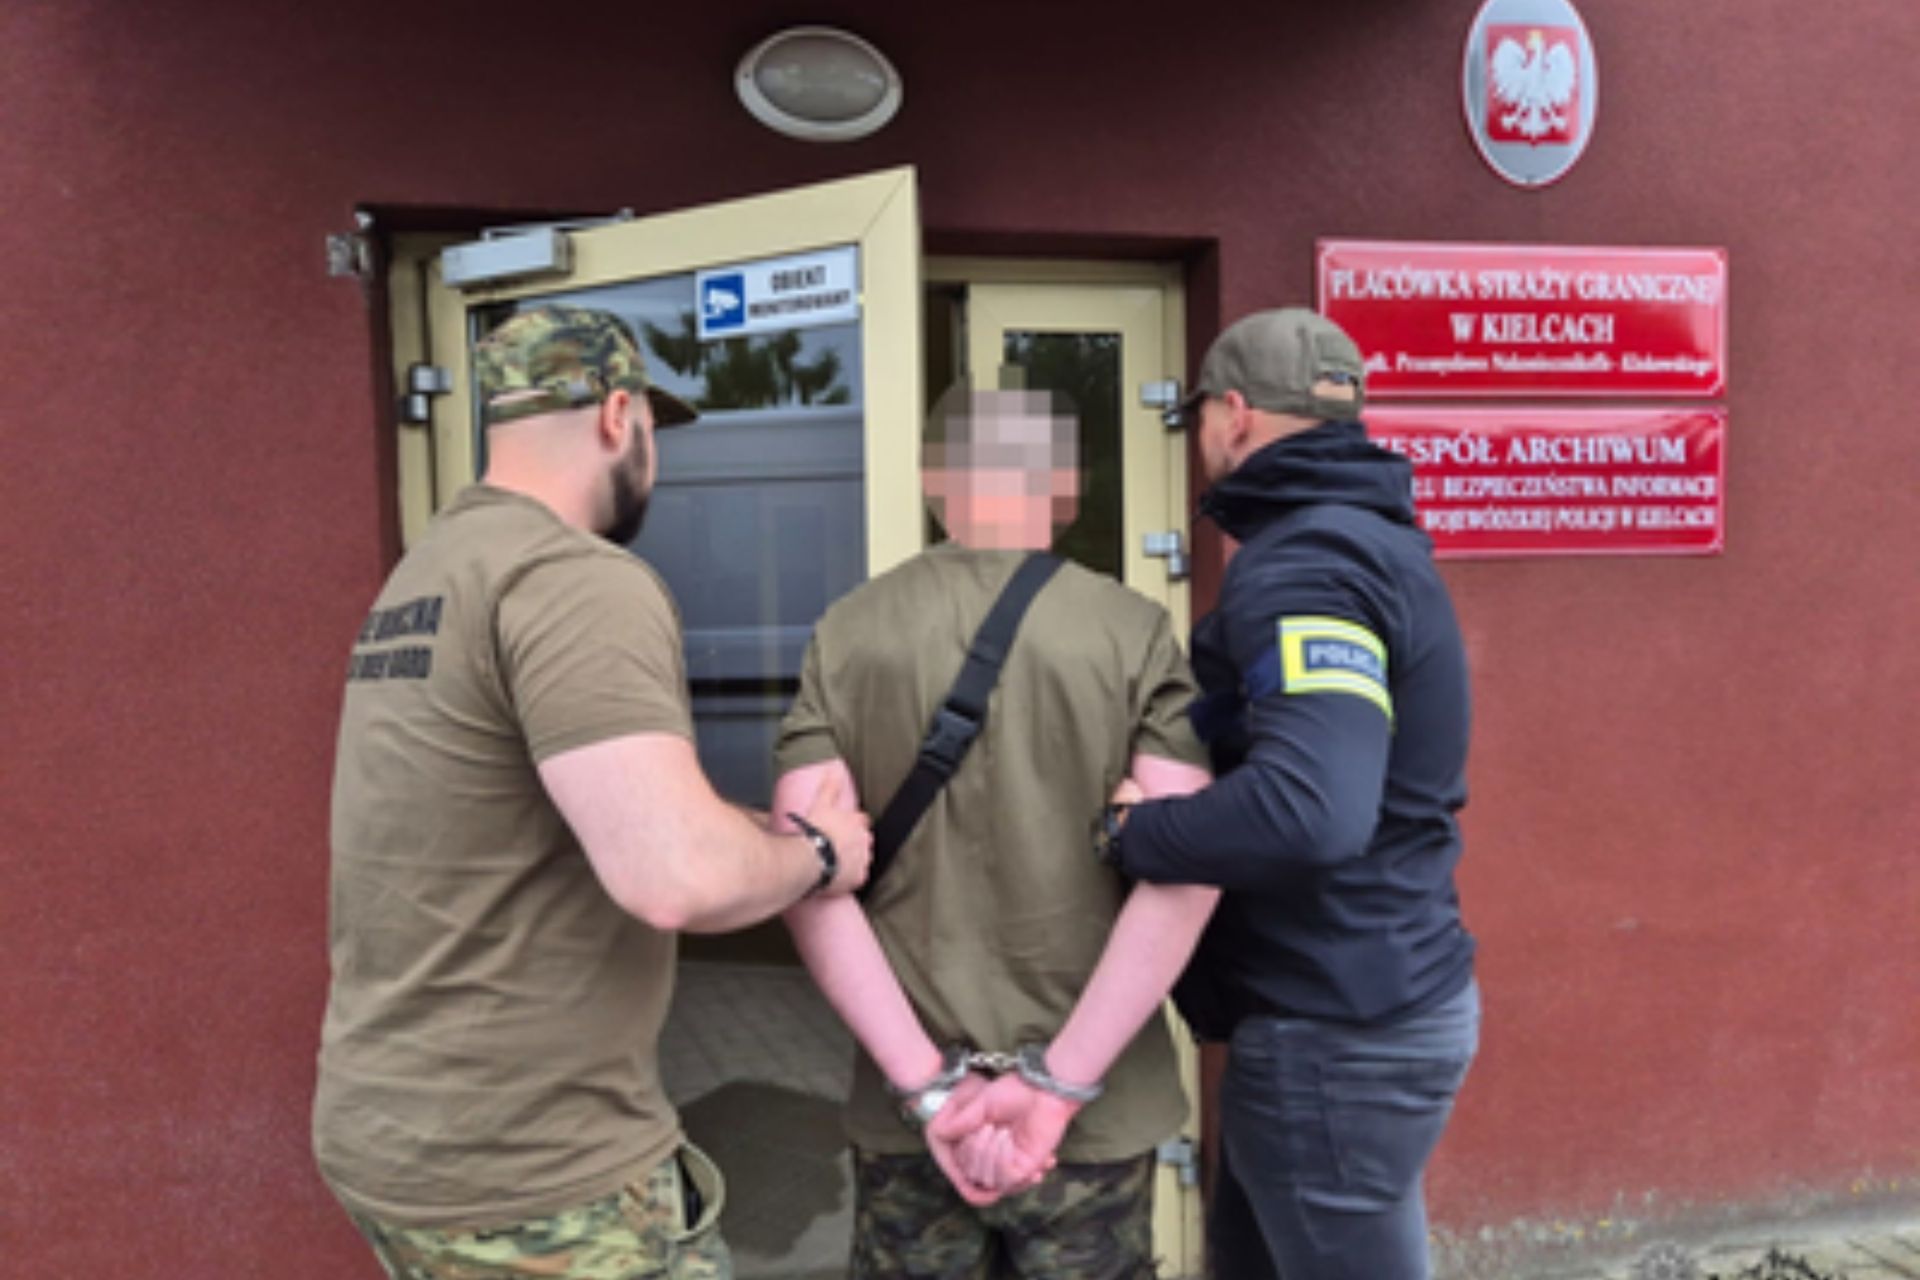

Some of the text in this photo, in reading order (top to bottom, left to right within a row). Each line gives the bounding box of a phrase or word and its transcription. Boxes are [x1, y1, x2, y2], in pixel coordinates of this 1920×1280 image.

[1330, 263, 1473, 299] PLACÓWKA
[1478, 264, 1569, 300] STRAŻY
[1449, 312, 1615, 344] W KIELCACH
[1506, 435, 1687, 464] ARCHIWUM
[1443, 470, 1609, 498] BEZPIECZEŃSTWA
